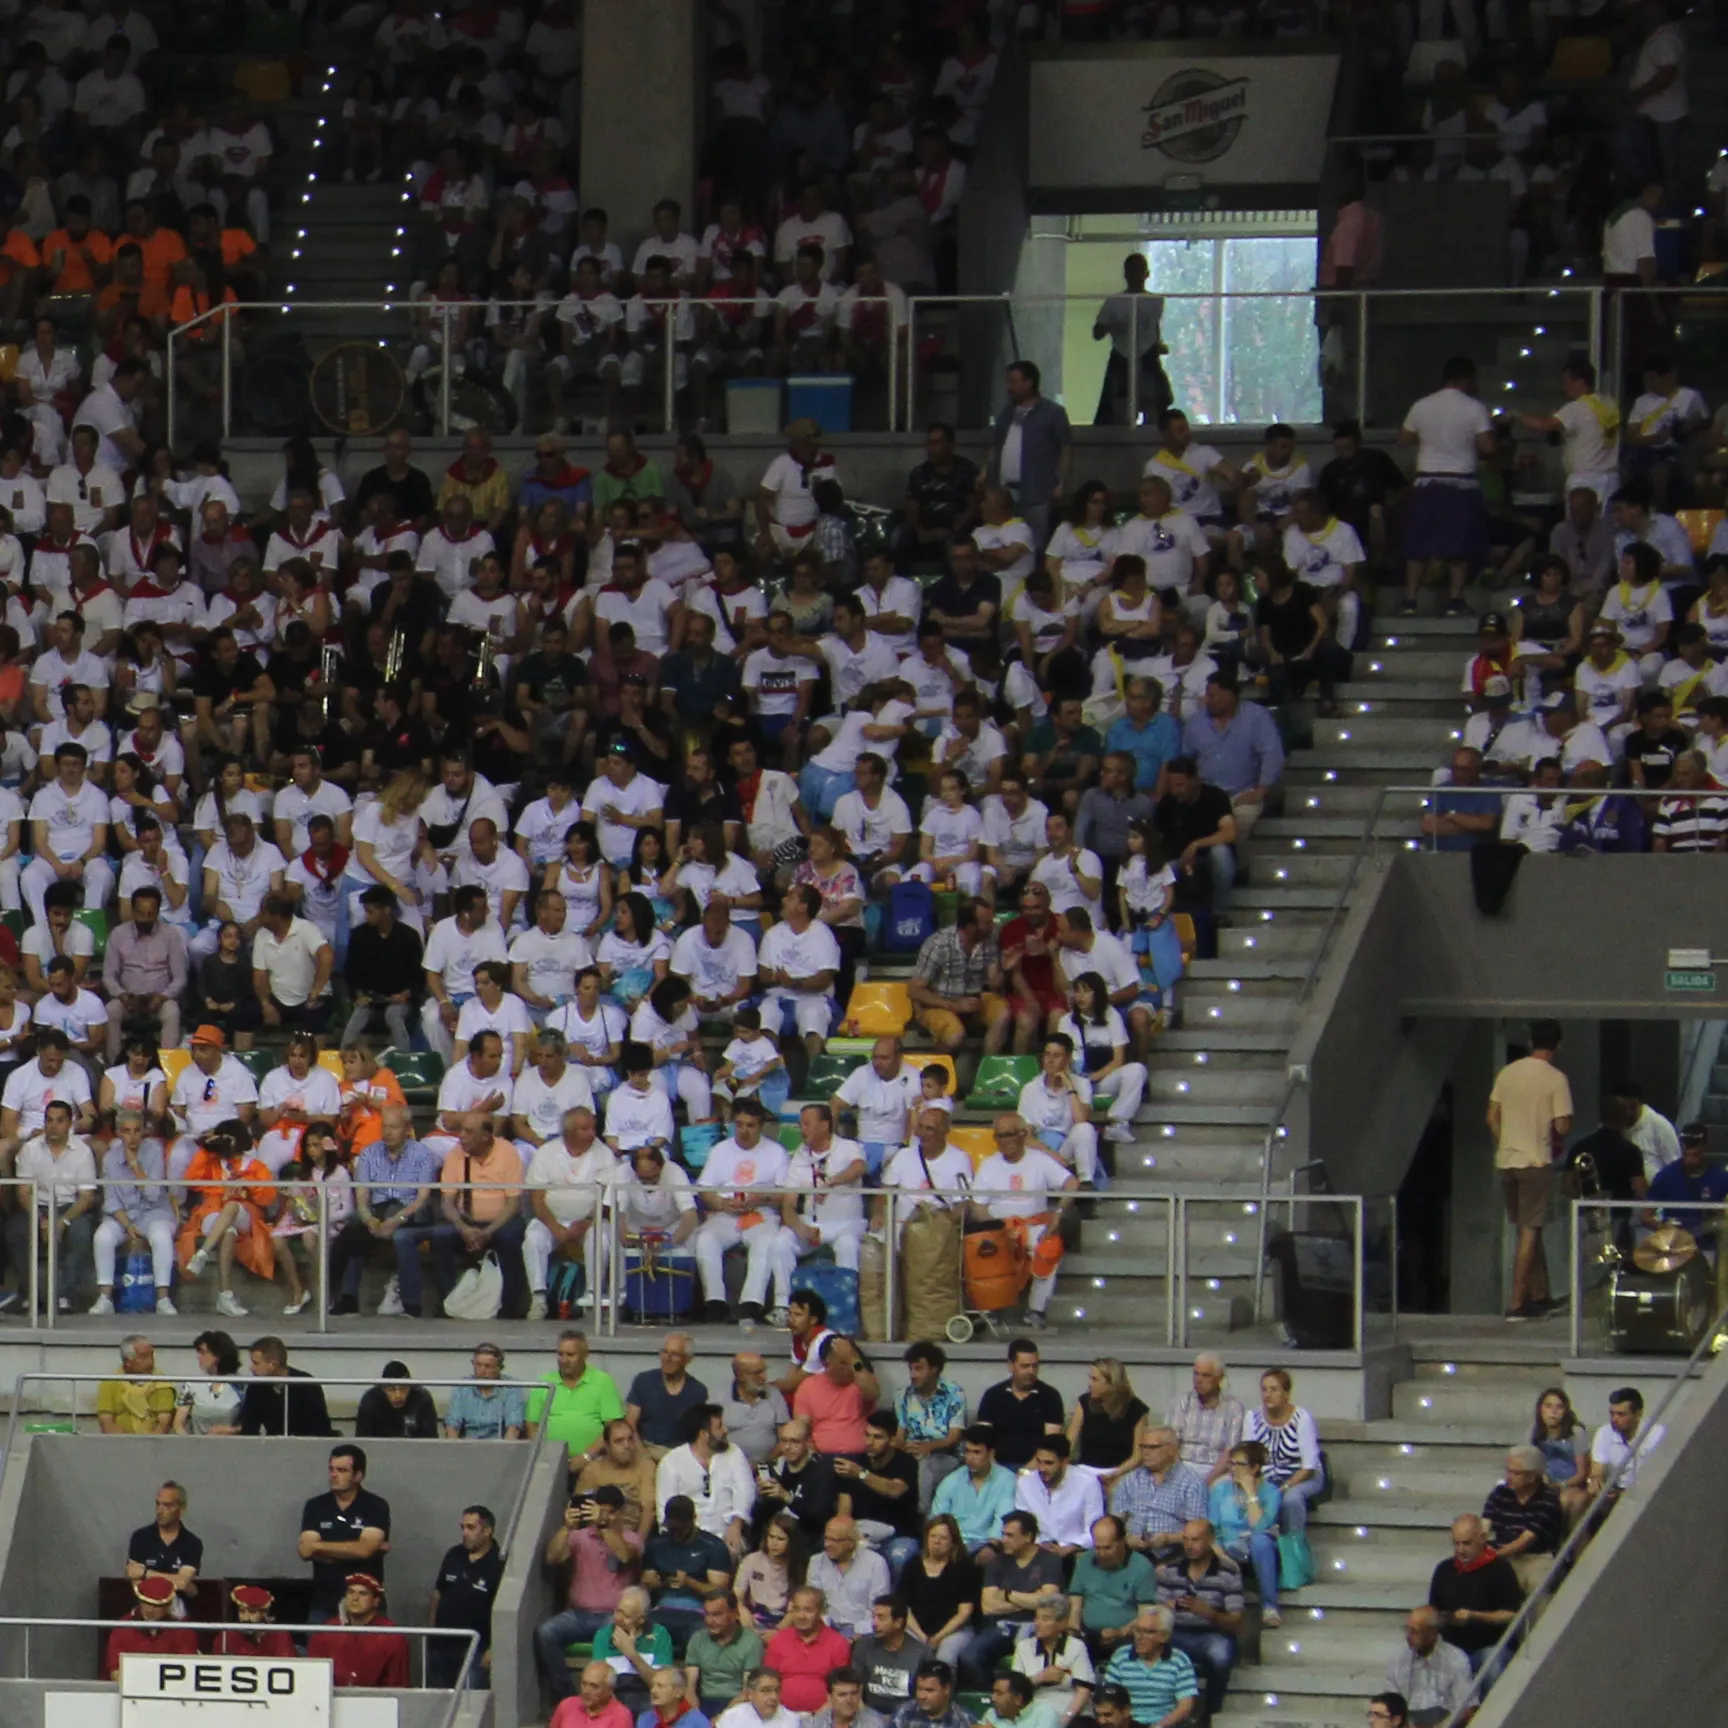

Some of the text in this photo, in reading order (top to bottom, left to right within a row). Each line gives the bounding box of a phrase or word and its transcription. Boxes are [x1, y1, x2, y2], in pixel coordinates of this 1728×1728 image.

[1142, 88, 1246, 142] San Miguel
[158, 1664, 295, 1694] PESO
